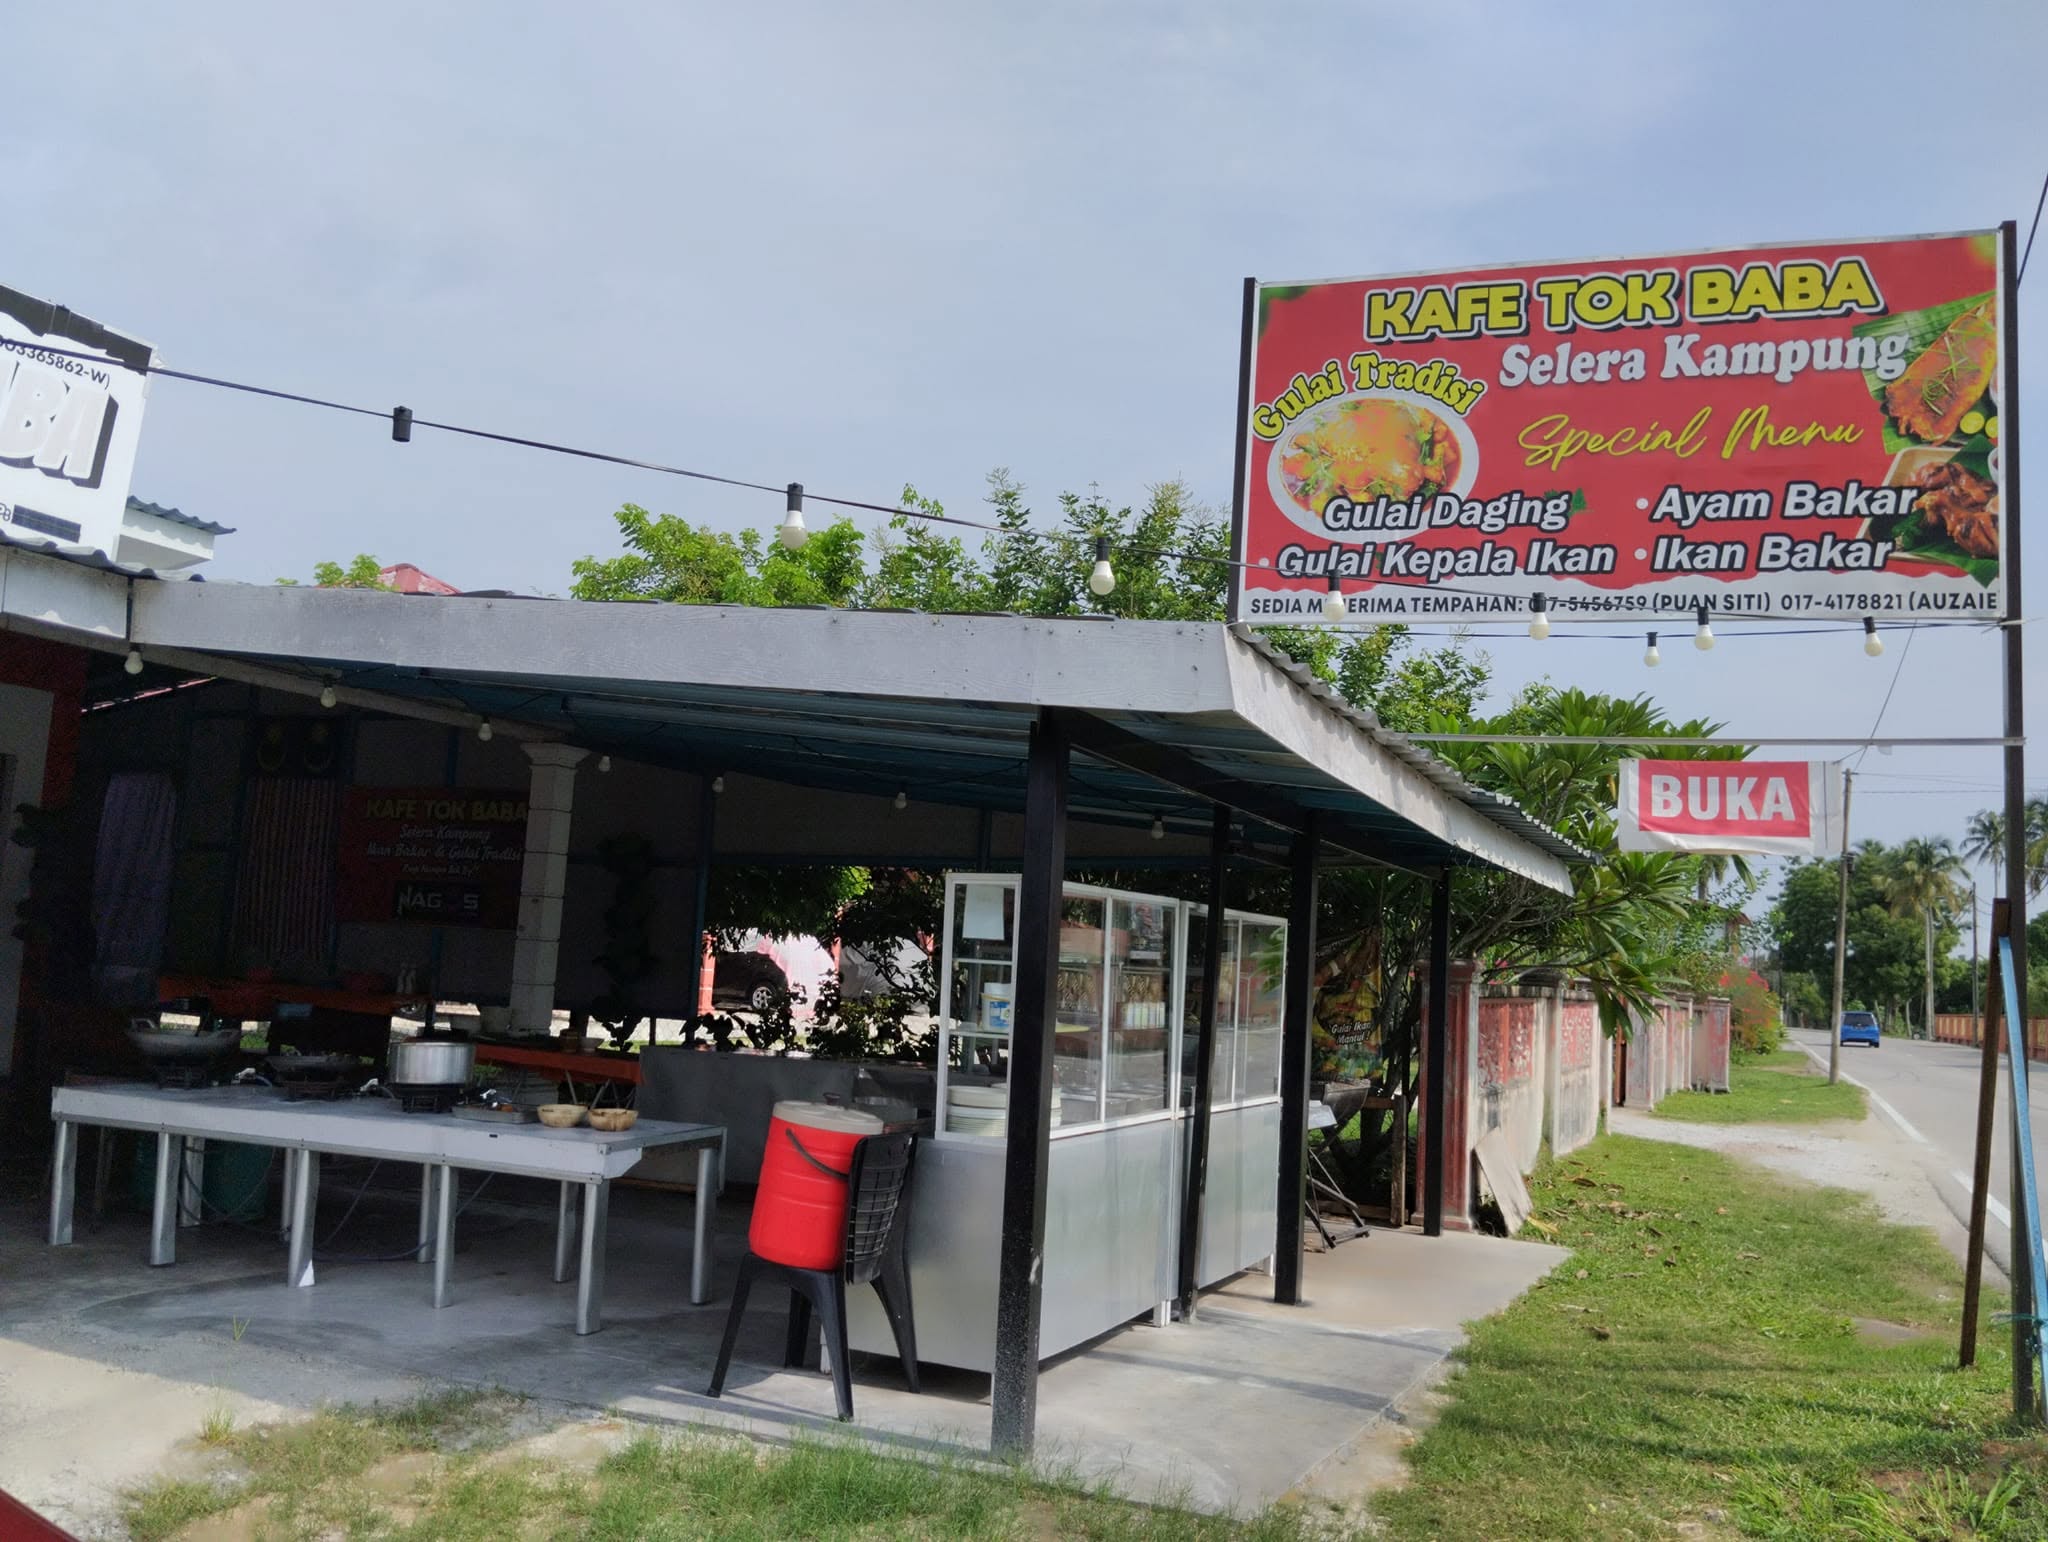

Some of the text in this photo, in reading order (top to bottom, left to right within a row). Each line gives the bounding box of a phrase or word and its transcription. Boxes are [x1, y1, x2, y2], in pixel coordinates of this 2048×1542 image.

[1365, 256, 1884, 341] KAFE TOK BABA
[1499, 332, 1909, 387] Selera Kampung
[1253, 352, 1487, 440] Gulai Tradisi
[1518, 404, 1863, 471] Special Menu
[1323, 491, 1572, 533] Gulai Daging
[1651, 480, 1919, 527] Ayam Bakar
[1277, 540, 1617, 584] Gulai Kepala Ikan
[1650, 532, 1894, 573] Ikan Bakar
[1250, 597, 1302, 614] SEDIA
[1307, 596, 1406, 613] MERIMA
[1411, 595, 1523, 613] TEMPAHAN:
[1652, 592, 1717, 613] (PUAN
[1723, 592, 1771, 612] SITI)
[1780, 593, 1902, 611] 017-4178821
[1908, 590, 1998, 611] (AUZAIE
[366, 799, 417, 819] KAFE
[425, 799, 467, 821] TOK
[1650, 774, 1796, 822] BUKA
